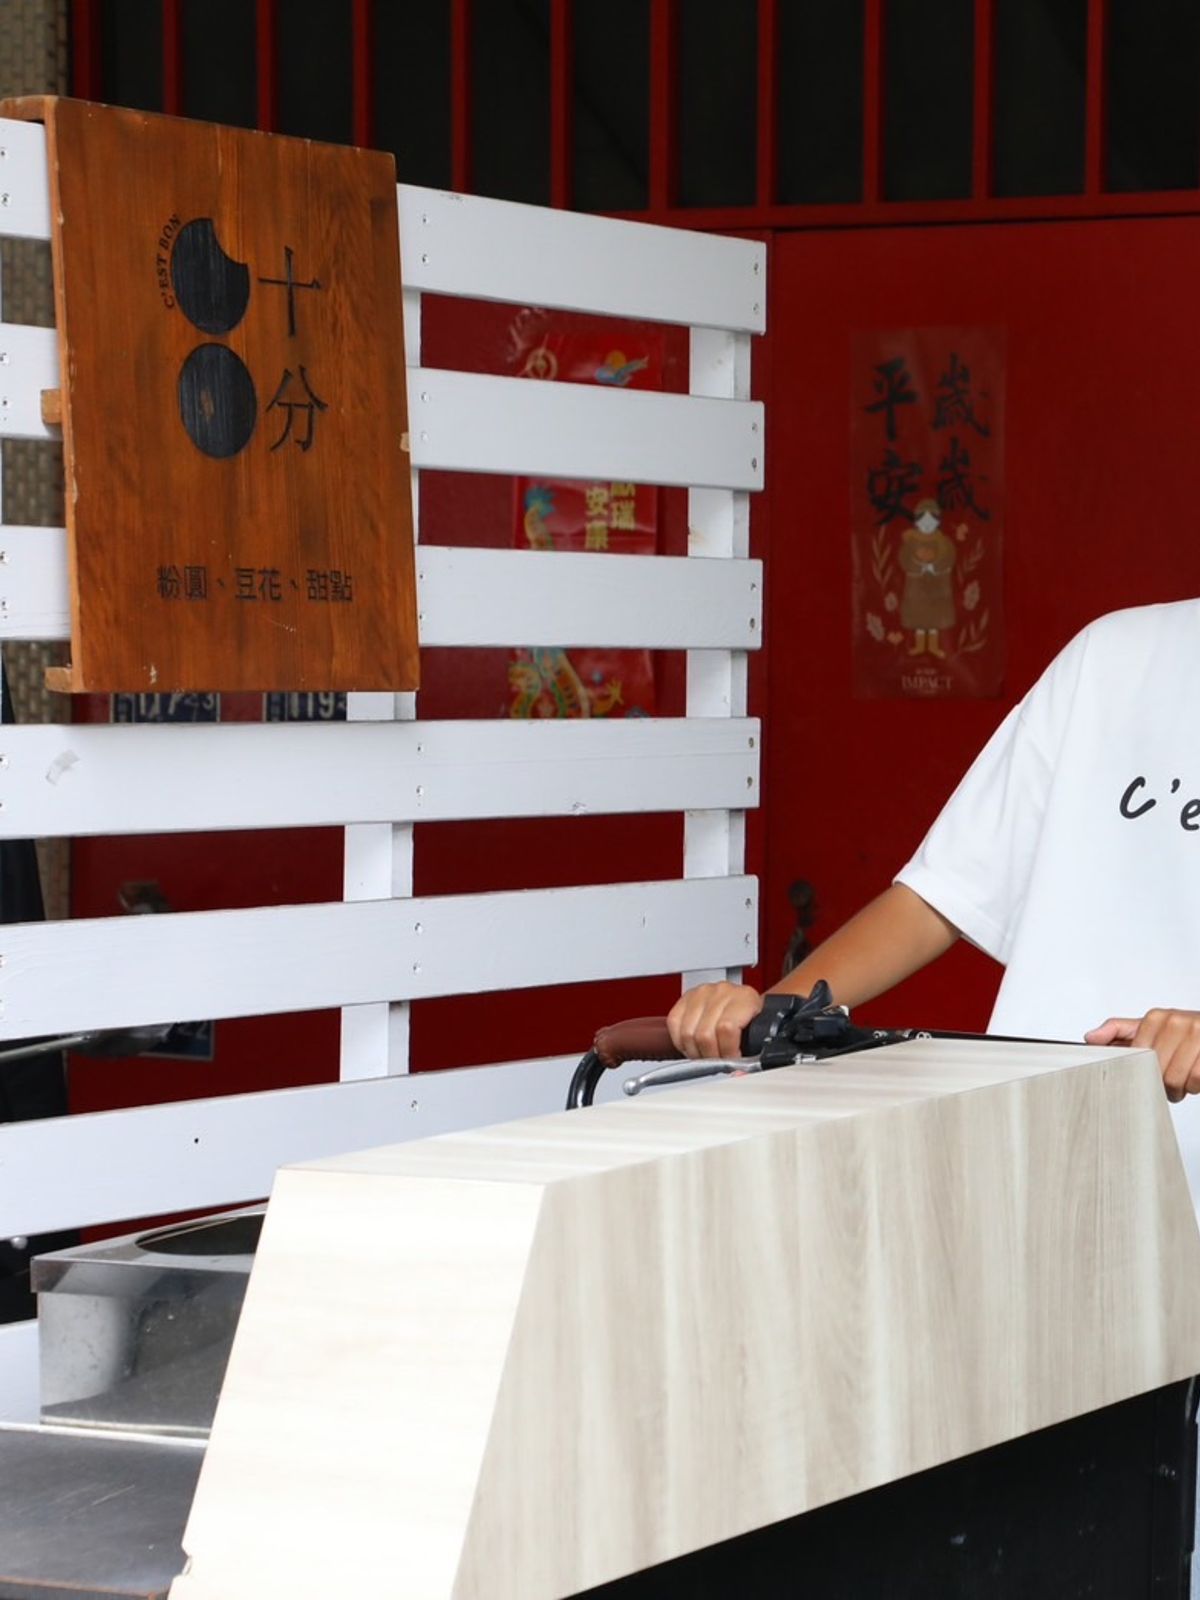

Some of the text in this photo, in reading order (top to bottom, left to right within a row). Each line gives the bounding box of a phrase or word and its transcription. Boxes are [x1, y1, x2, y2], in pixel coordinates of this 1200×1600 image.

[159, 214, 183, 249] BON
[258, 245, 329, 452] 十分
[864, 356, 923, 527] 平安
